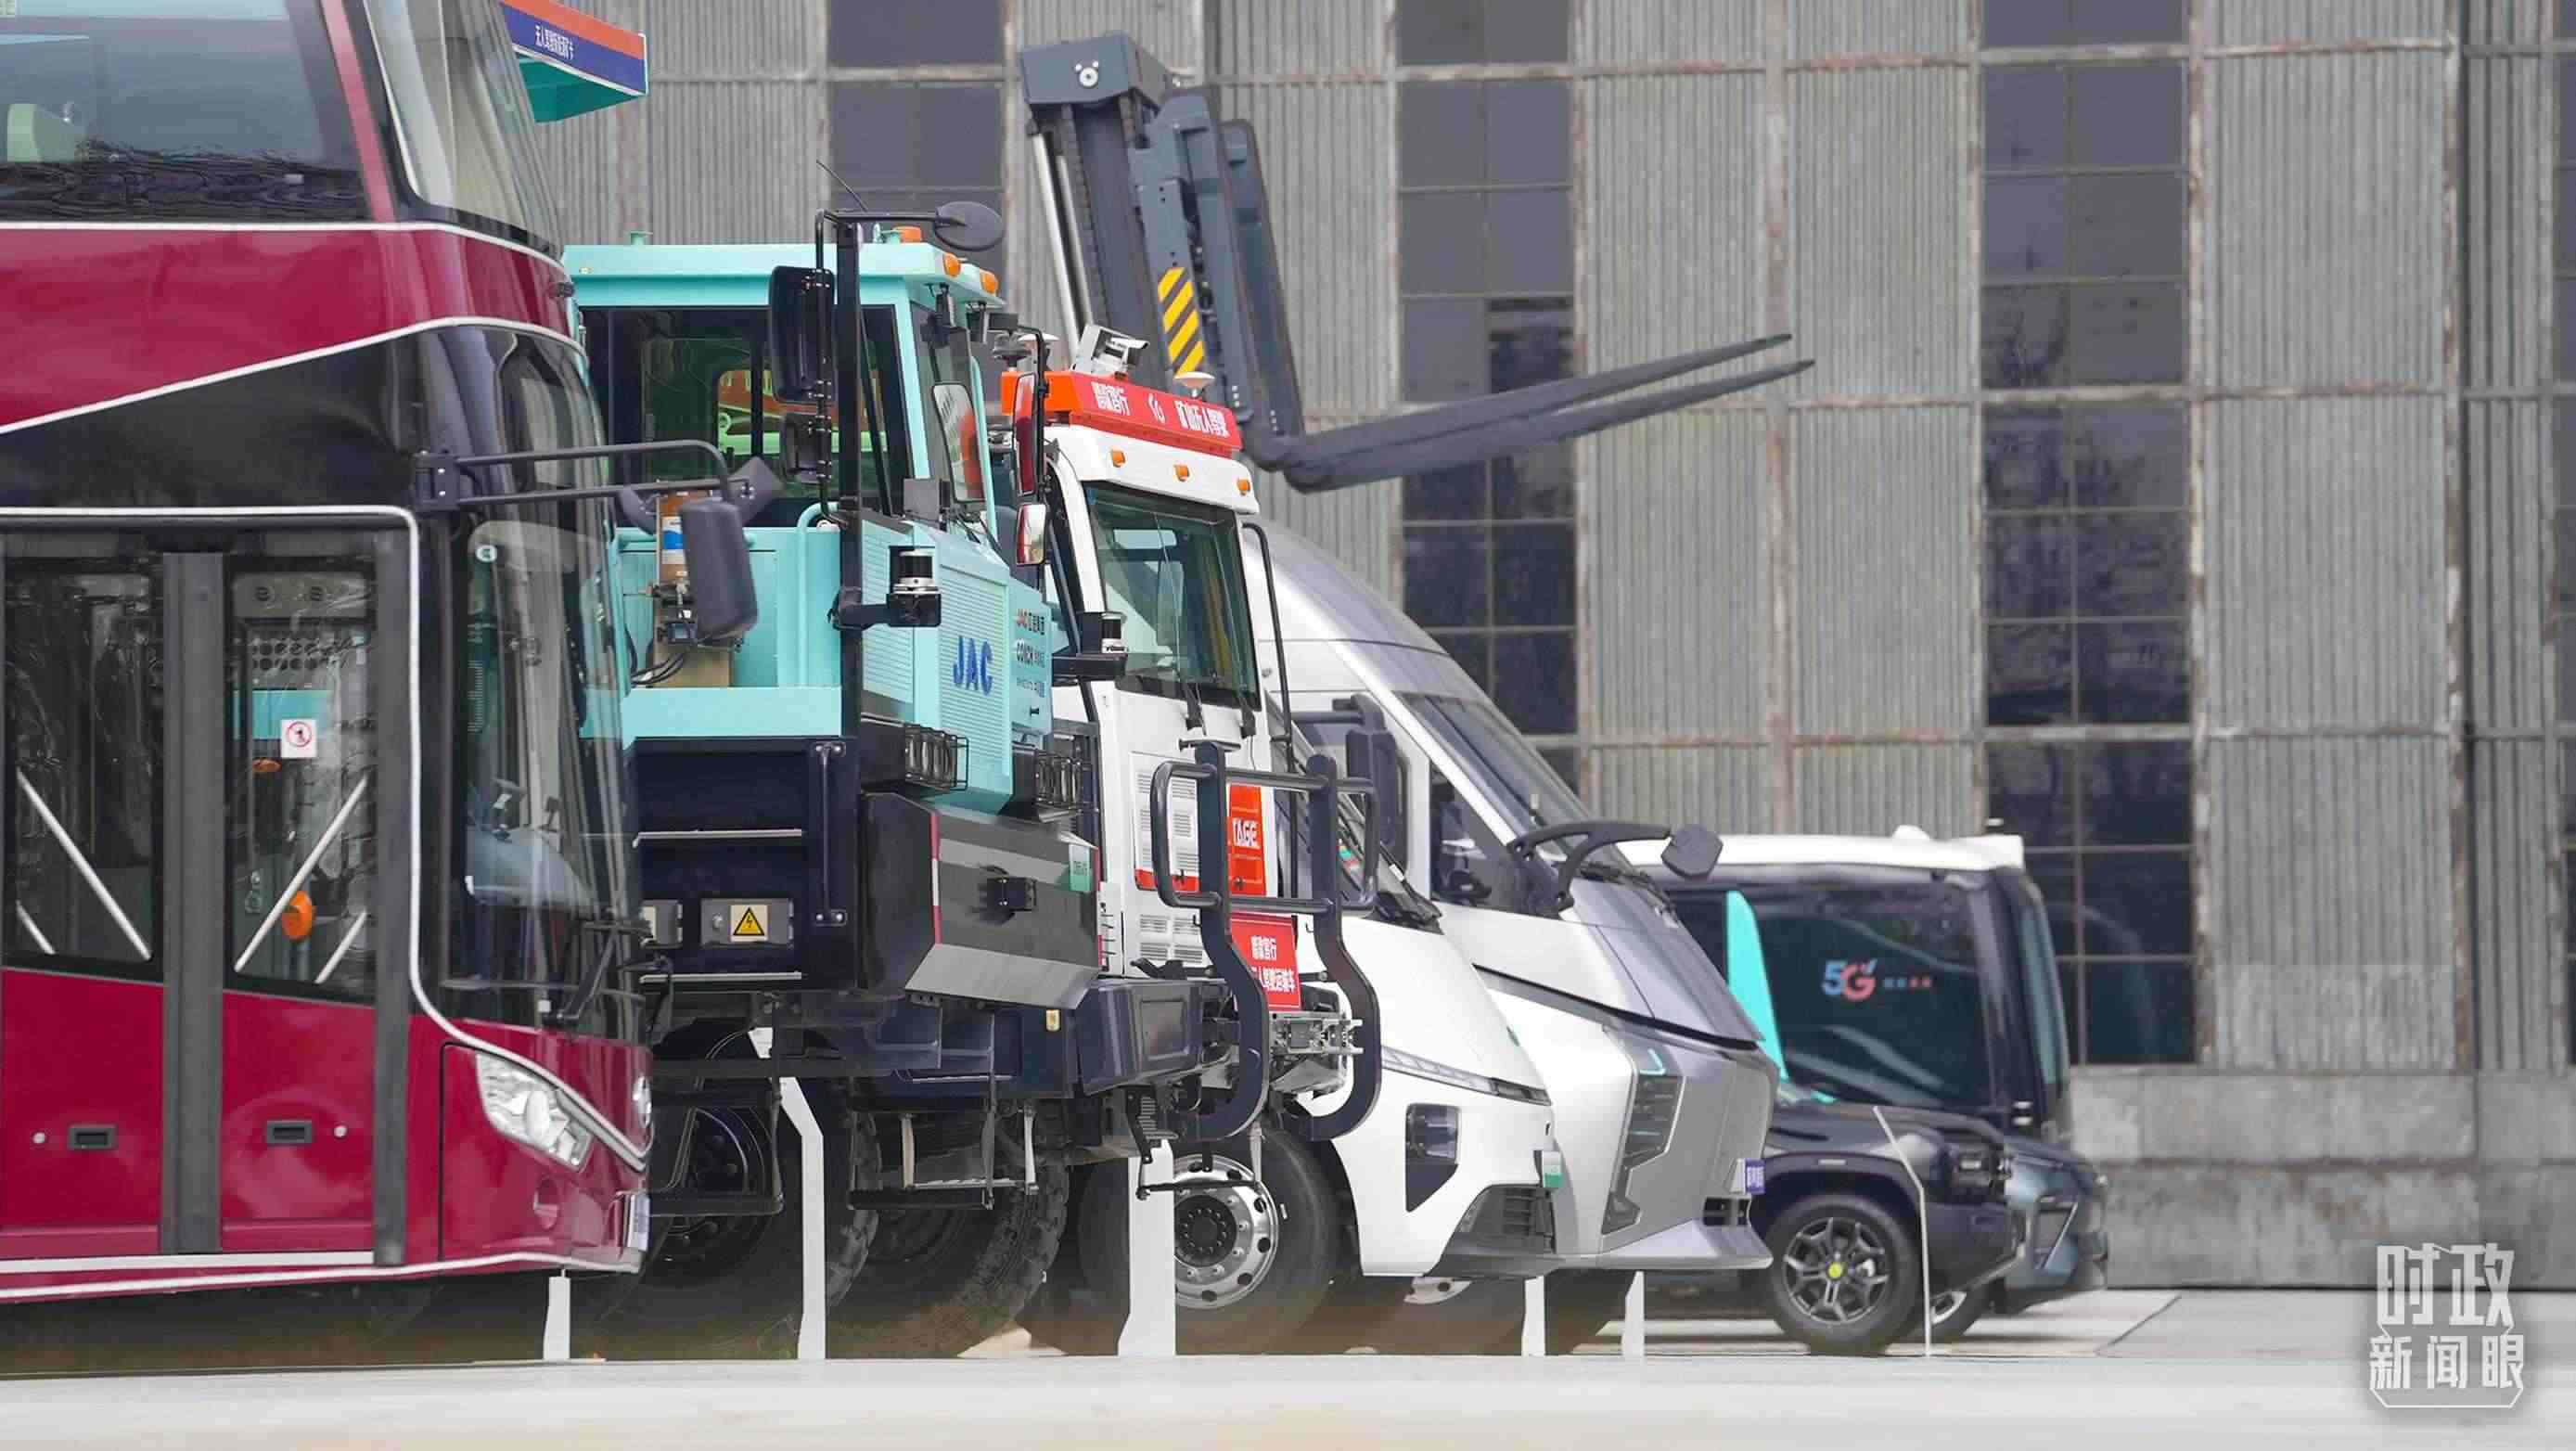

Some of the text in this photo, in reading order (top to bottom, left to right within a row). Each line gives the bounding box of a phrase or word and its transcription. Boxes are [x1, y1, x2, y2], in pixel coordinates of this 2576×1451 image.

[954, 636, 993, 696] JAC
[1232, 820, 1261, 850] TAGE
[1821, 958, 1878, 1003] 5G
